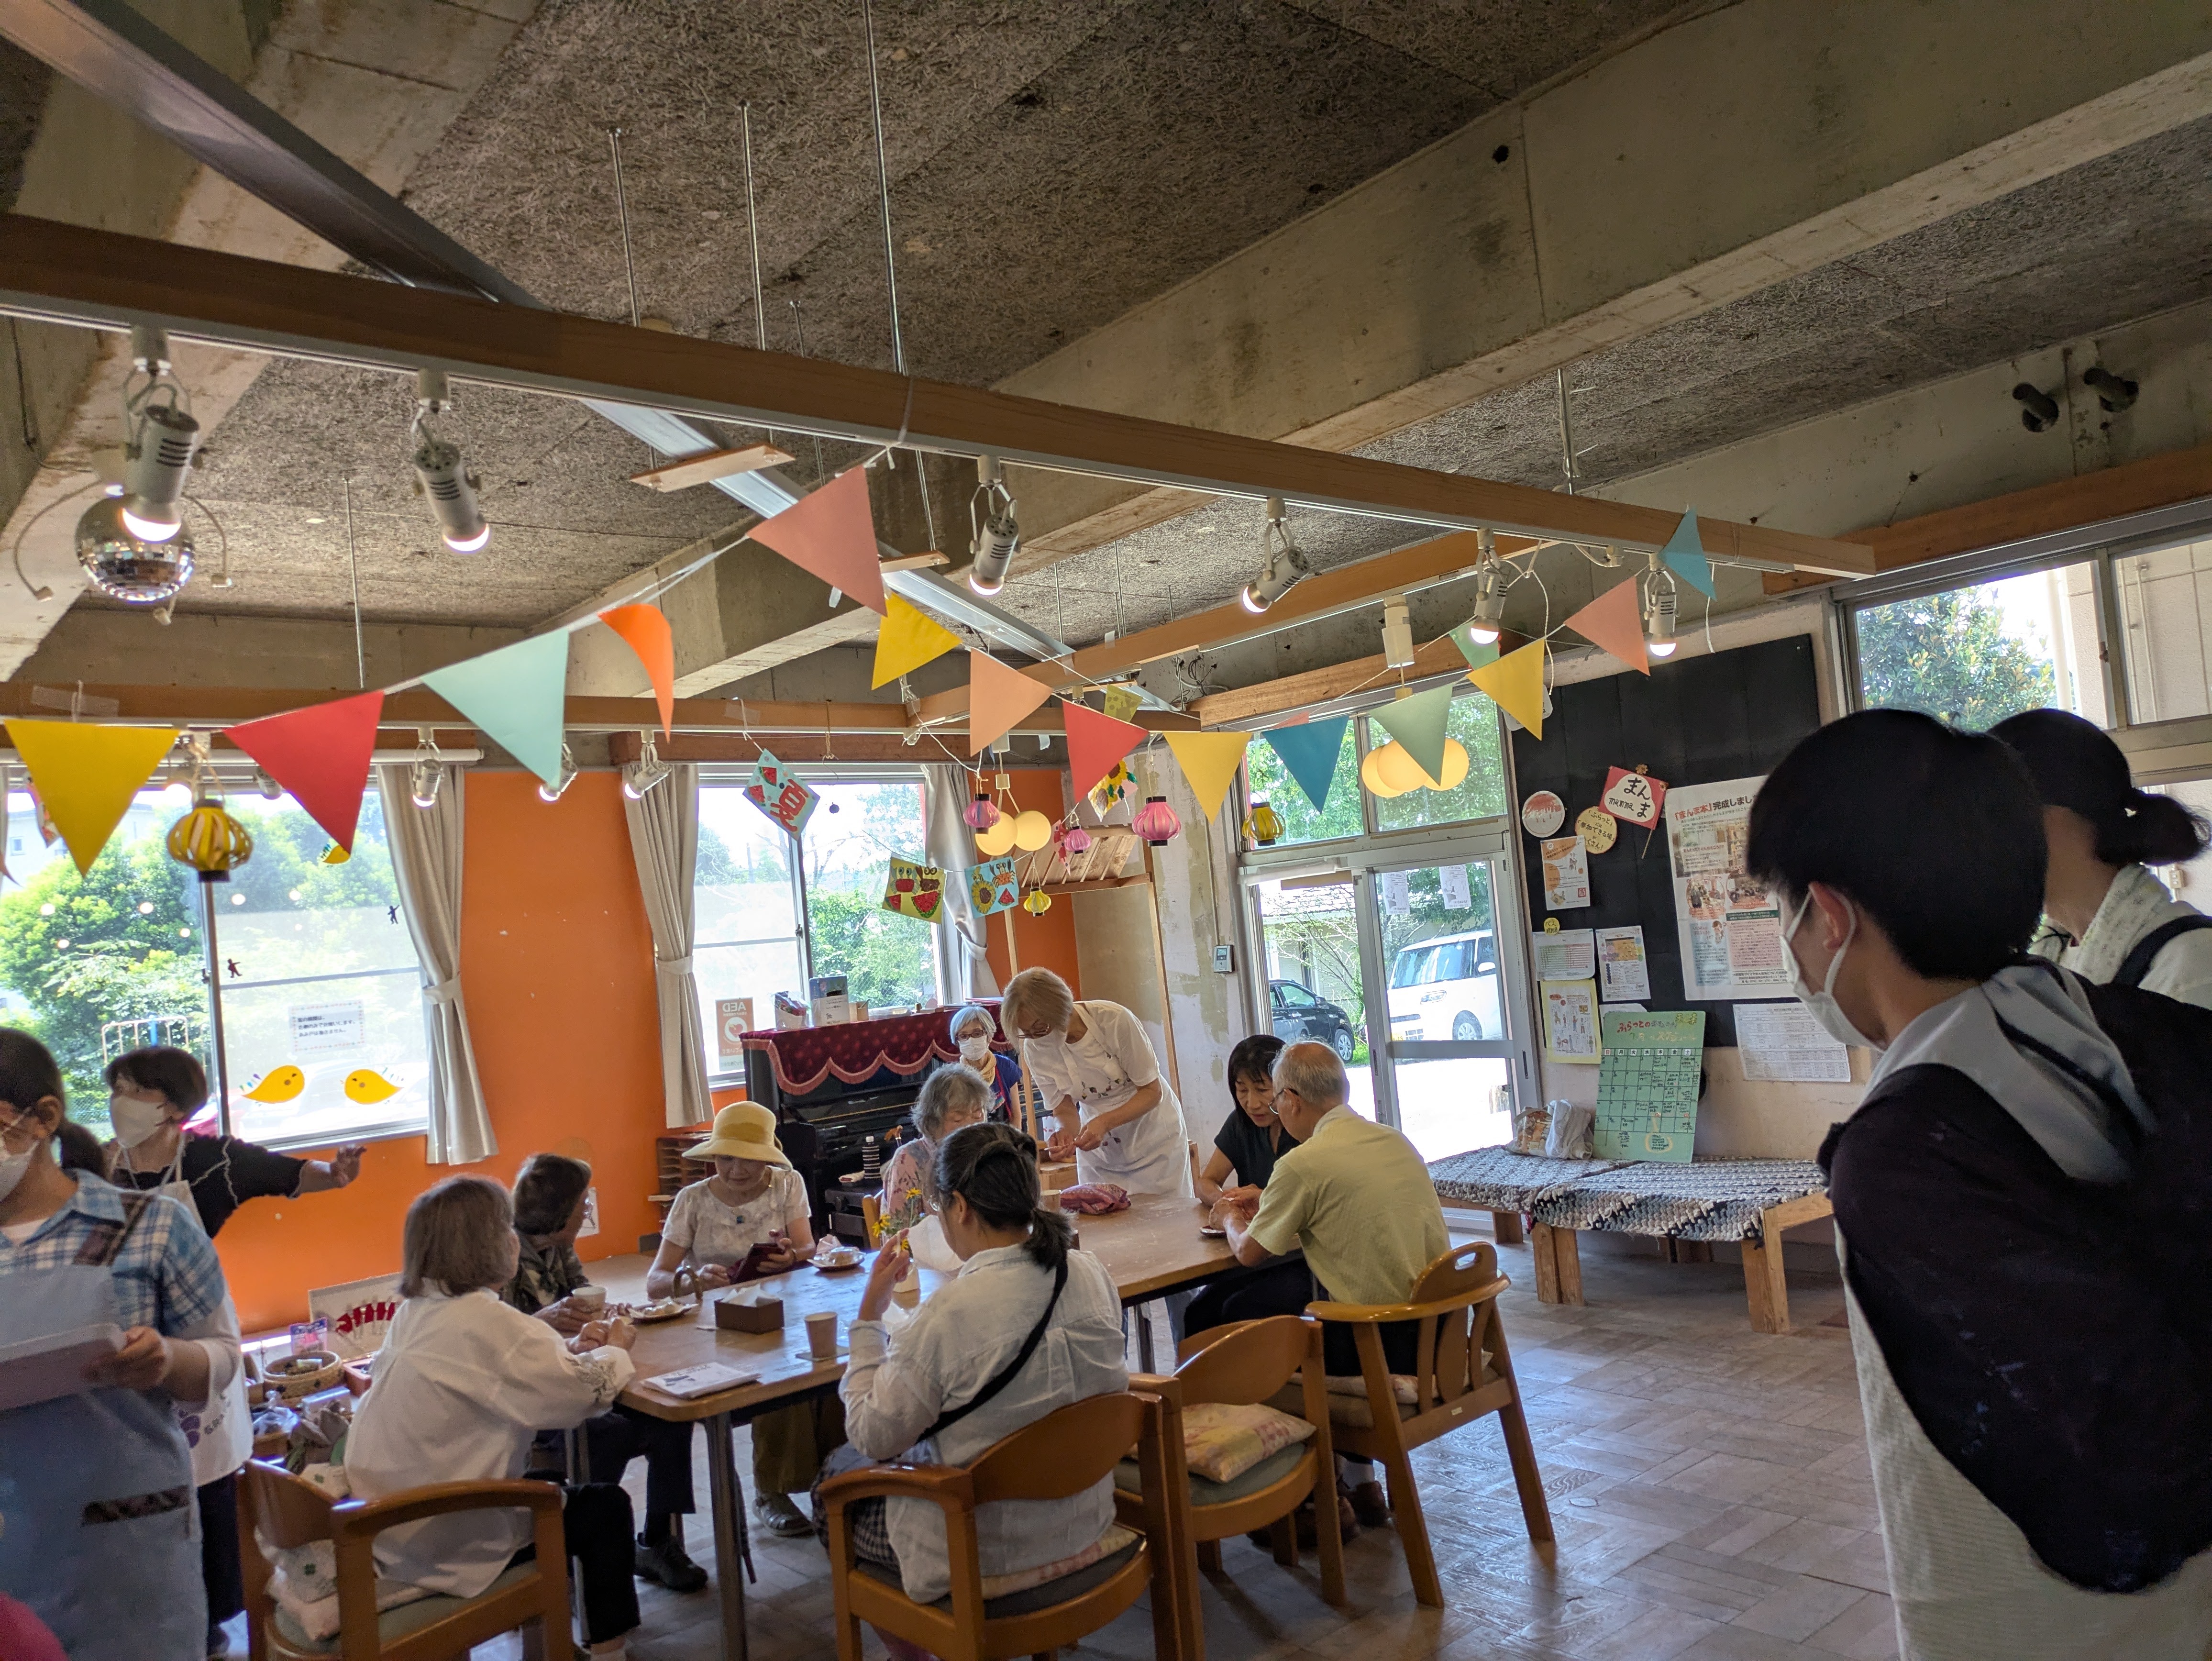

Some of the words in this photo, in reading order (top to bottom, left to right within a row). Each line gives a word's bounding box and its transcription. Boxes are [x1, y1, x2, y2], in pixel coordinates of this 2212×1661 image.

[1623, 777, 1650, 800] まん
[770, 778, 810, 832] 夏
[1637, 801, 1650, 818] ま
[1675, 795, 1756, 821] 「まんま本」完成しまし
